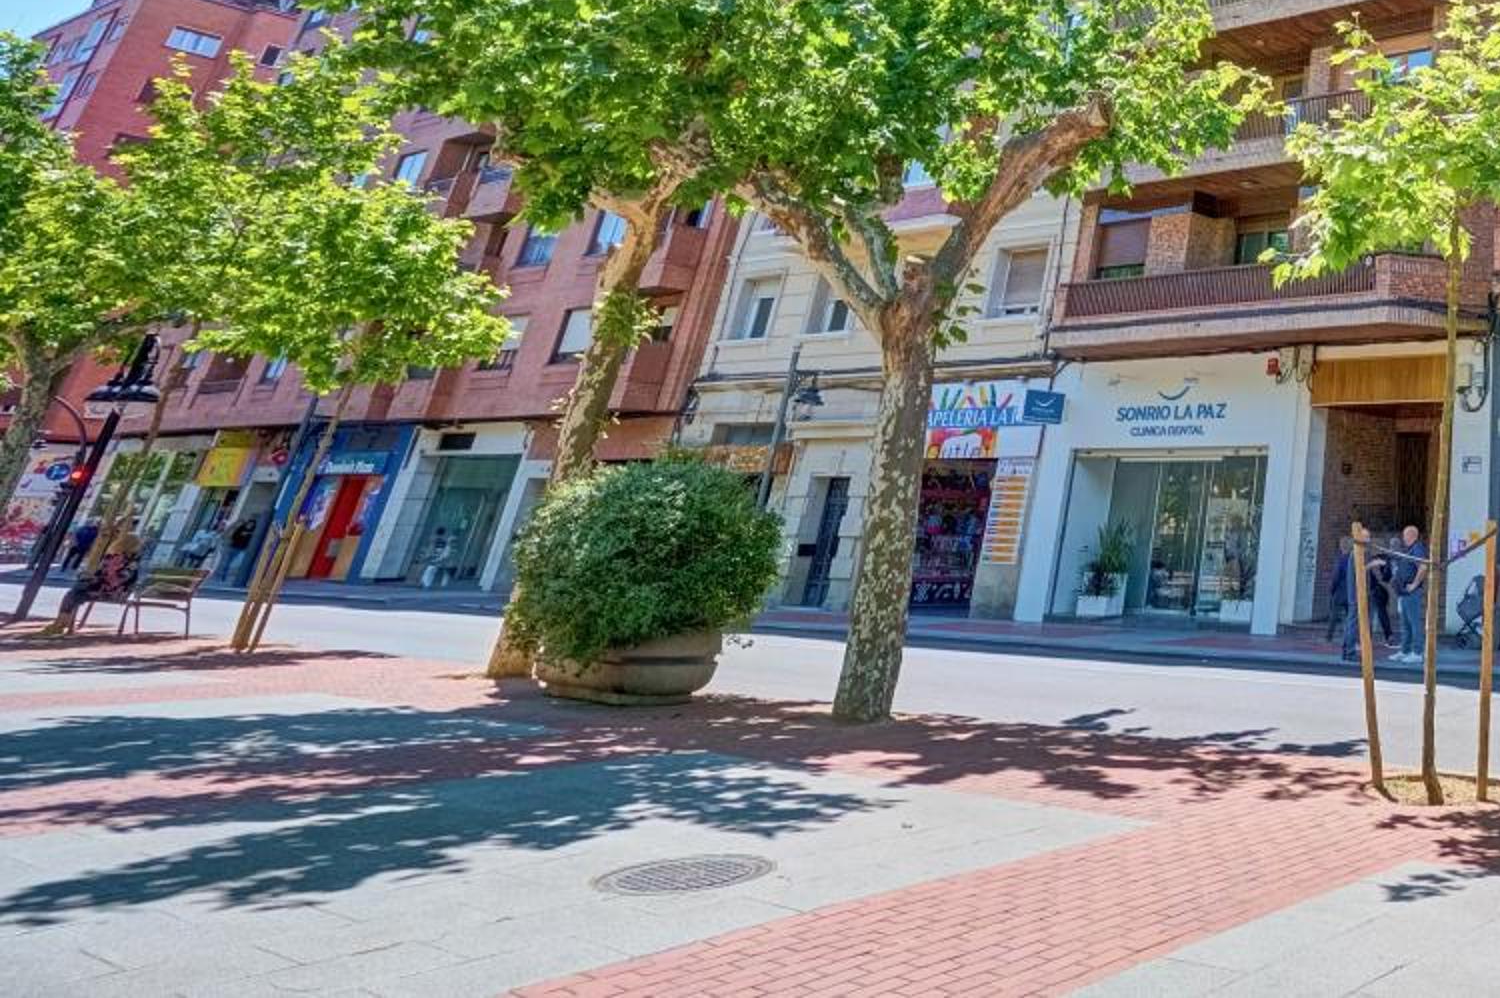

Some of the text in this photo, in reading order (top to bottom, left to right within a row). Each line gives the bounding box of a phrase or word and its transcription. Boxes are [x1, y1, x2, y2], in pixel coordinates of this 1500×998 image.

[927, 407, 987, 426] APELERIA
[1116, 403, 1227, 422] SONRIO LA PAZ
